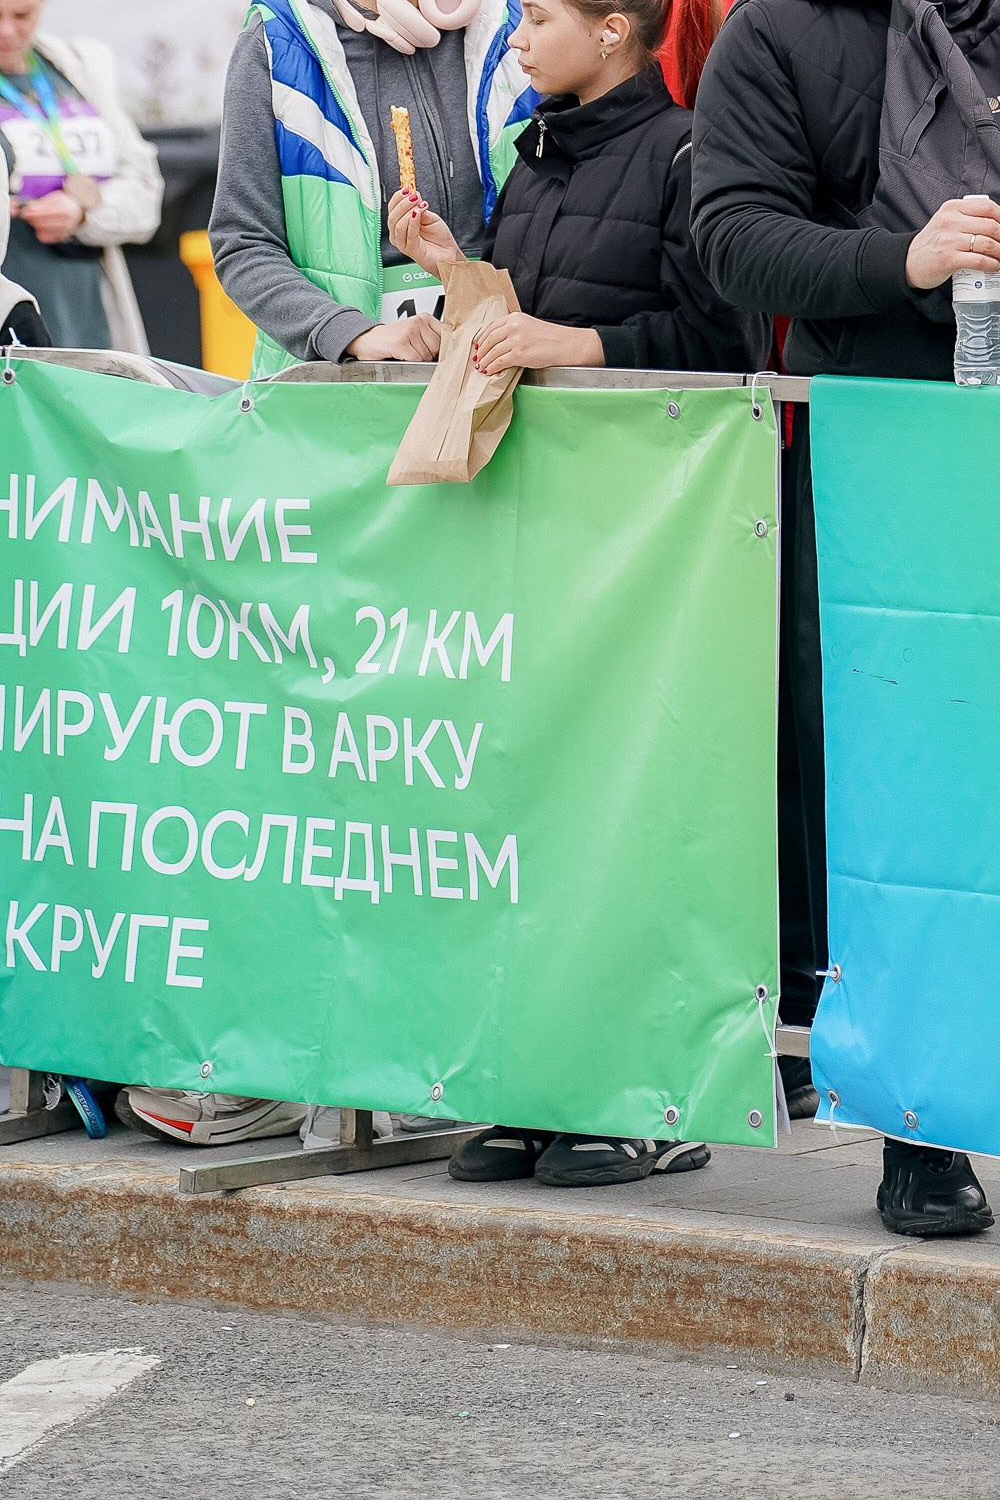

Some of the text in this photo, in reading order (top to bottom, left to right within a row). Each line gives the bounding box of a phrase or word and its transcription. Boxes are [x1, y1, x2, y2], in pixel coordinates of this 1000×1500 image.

[0, 683, 483, 791] ИРУЮТ В АРКУ
[89, 800, 519, 904] ПОСЛЕДНЕМ
[5, 900, 209, 989] КРУГЕ
